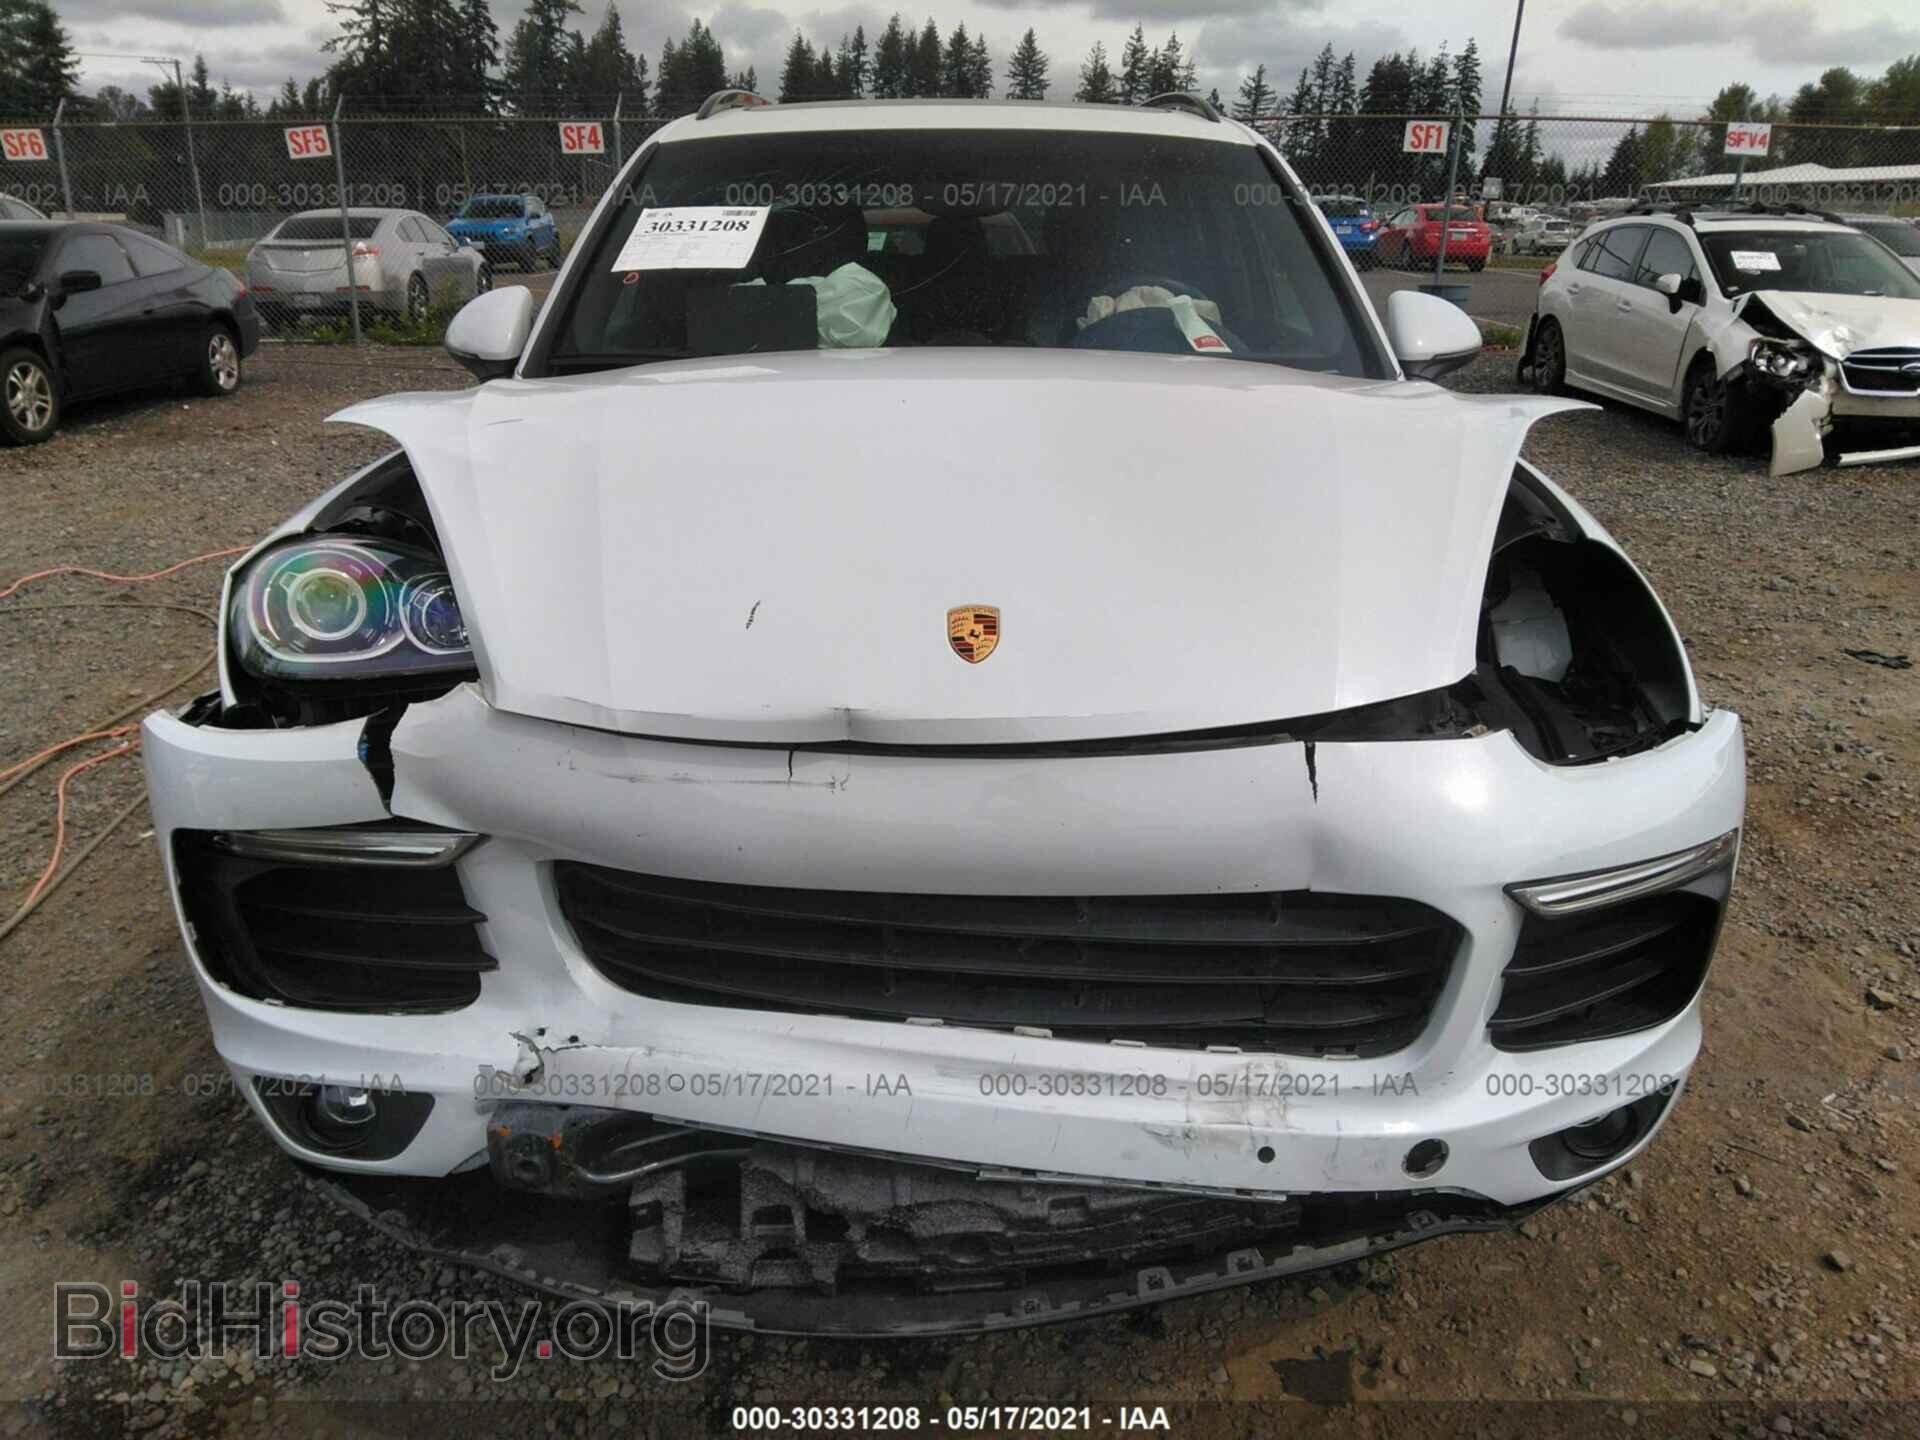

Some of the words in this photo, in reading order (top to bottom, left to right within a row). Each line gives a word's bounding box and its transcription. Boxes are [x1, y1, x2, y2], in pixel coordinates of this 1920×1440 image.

[3, 132, 44, 157] SF6
[288, 128, 327, 155] SF5
[563, 126, 601, 150] SF4
[1410, 124, 1443, 149] SF1
[1726, 131, 1768, 148] SFV4
[644, 219, 750, 234] 30331208
